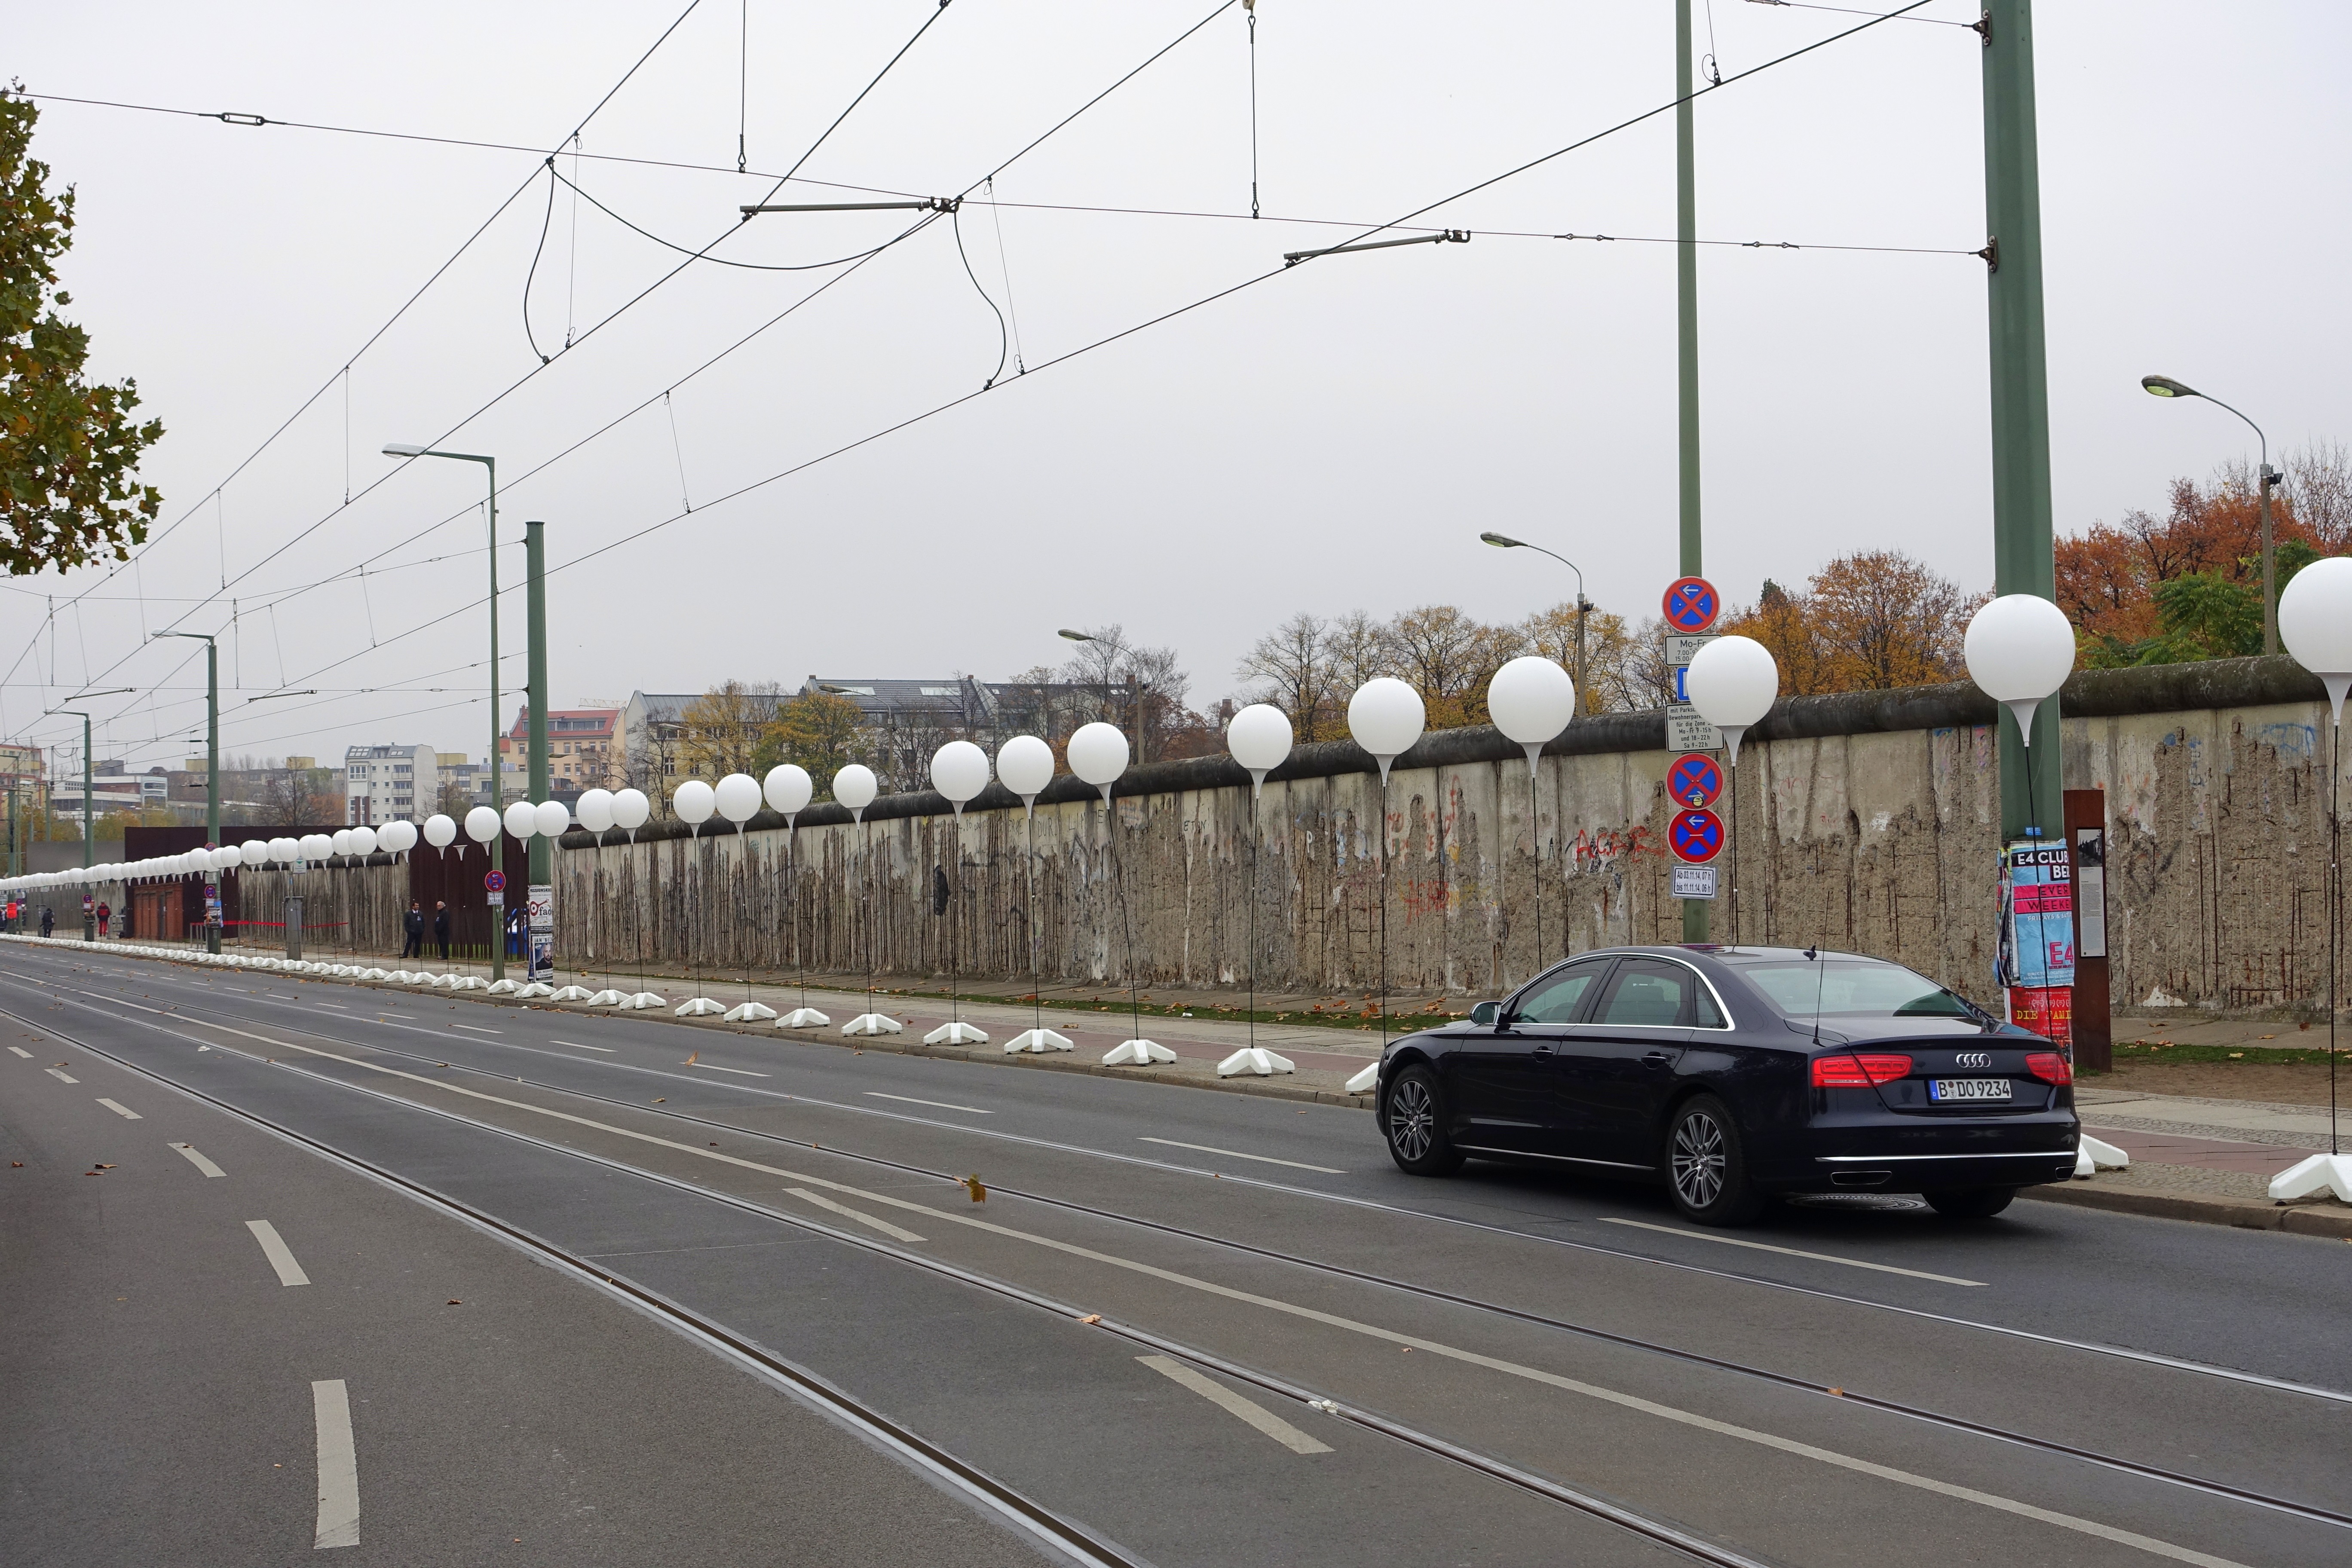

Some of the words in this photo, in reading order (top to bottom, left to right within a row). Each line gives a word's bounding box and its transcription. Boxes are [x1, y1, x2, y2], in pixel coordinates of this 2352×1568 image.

[1680, 640, 1706, 648] Mo-Fr
[2017, 852, 2034, 865] E4
[1677, 870, 1683, 879] Ab
[1684, 871, 1701, 881] 03.11.14,
[1702, 872, 1707, 880] 07
[1708, 872, 1711, 880] h
[1684, 883, 1701, 893] 11.11.14,
[1702, 884, 1707, 892] 06
[1708, 884, 1710, 892] h
[2049, 941, 2073, 965] E4
[2016, 1011, 2038, 1020] DIE
[1938, 1081, 1948, 1097] B
[1956, 1081, 1975, 1097] DO
[1977, 1081, 2010, 1096] 9234
